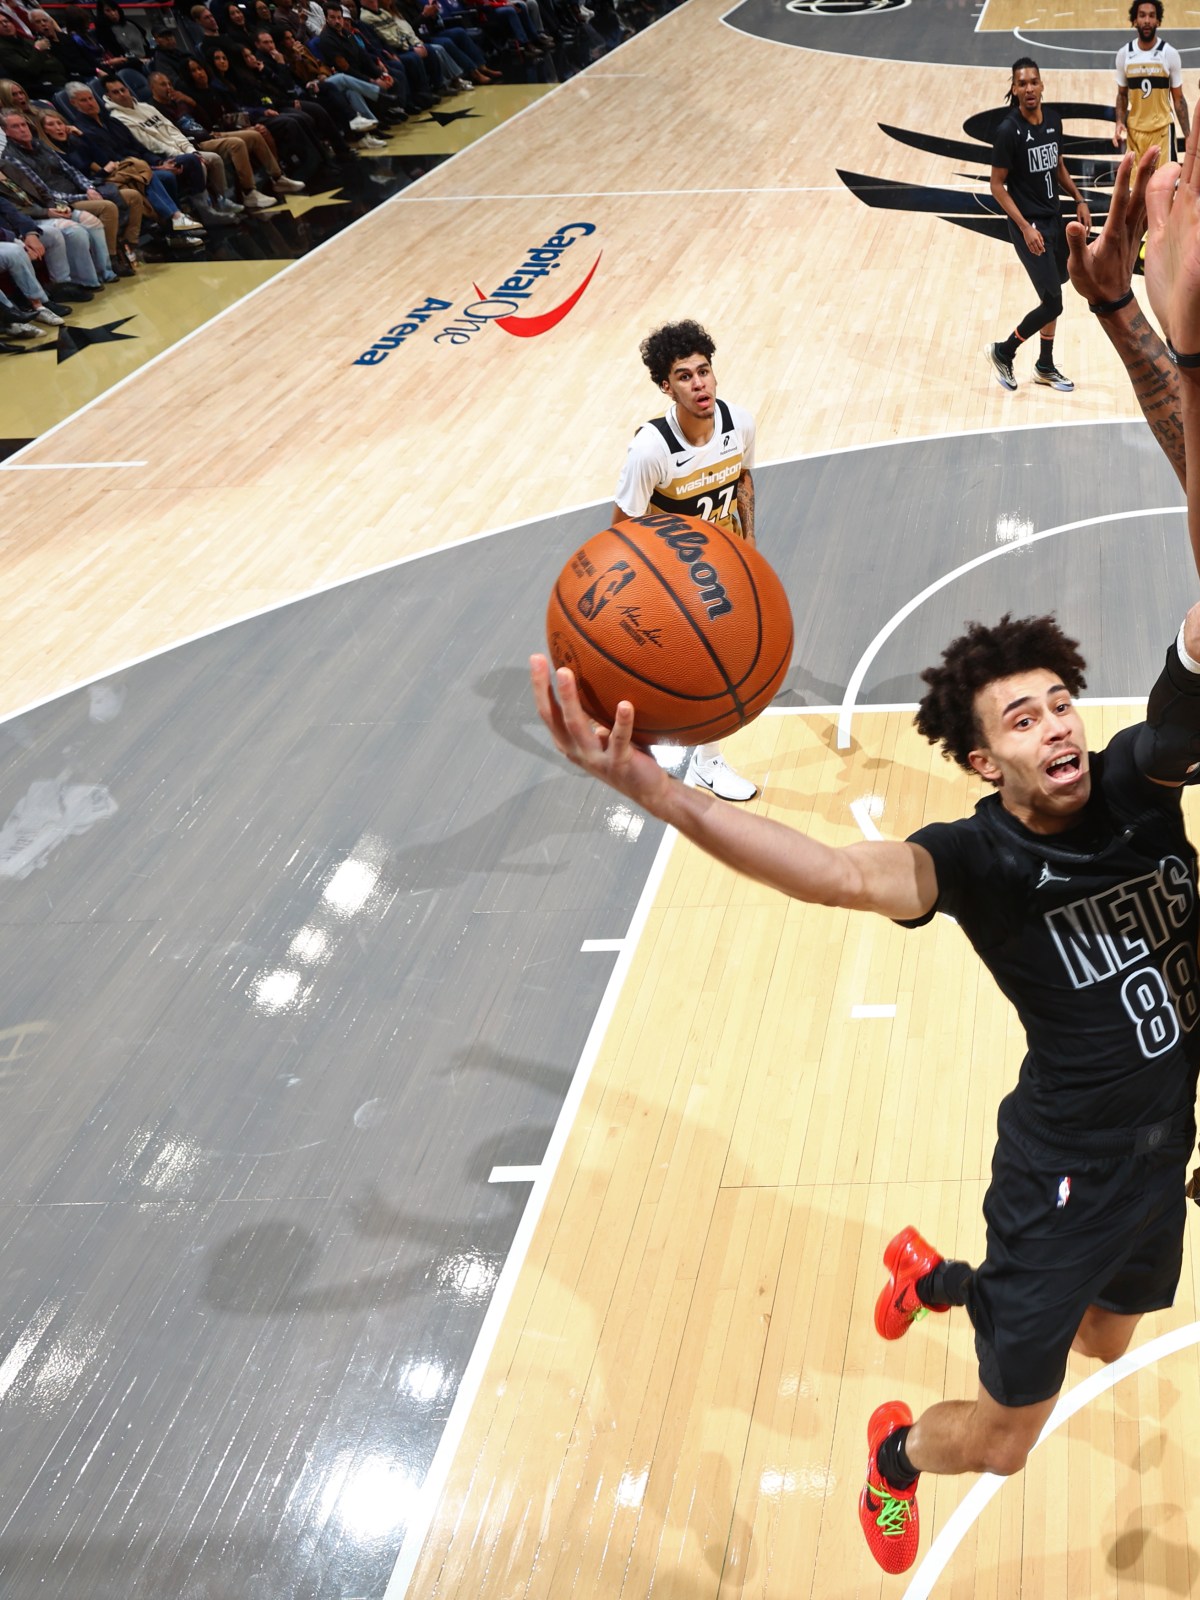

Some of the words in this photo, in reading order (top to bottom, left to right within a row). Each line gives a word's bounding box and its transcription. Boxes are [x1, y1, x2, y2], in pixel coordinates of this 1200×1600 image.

[1141, 78, 1152, 99] 9
[1027, 141, 1059, 173] NETS
[1044, 171, 1053, 199] 1
[491, 222, 597, 299] Capital
[352, 297, 454, 366] Arena
[434, 299, 519, 345] One
[675, 461, 742, 495] washington
[696, 485, 735, 523] 27
[1044, 855, 1194, 989] NETS
